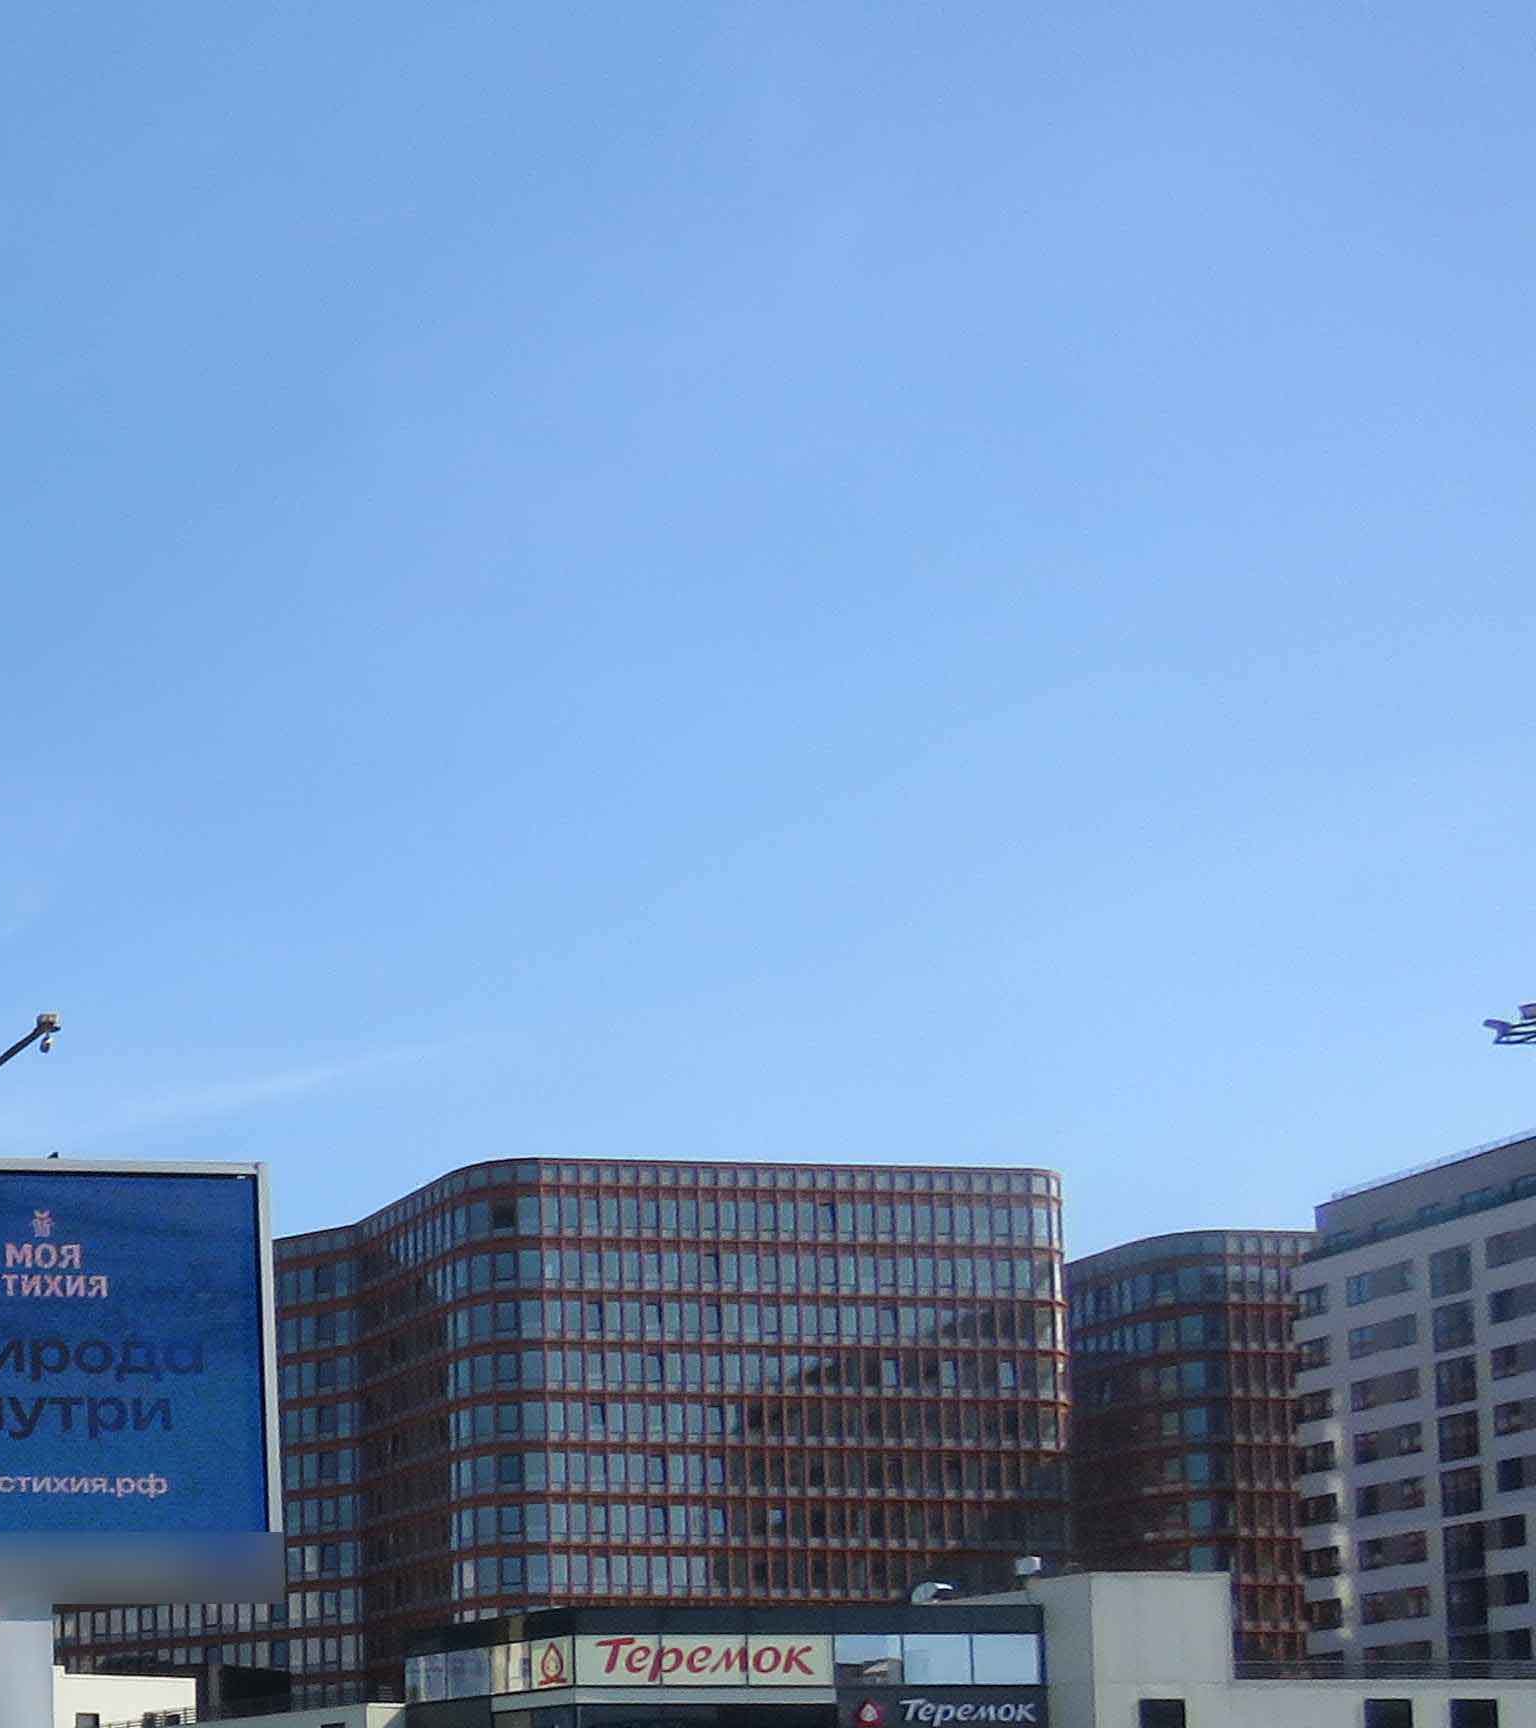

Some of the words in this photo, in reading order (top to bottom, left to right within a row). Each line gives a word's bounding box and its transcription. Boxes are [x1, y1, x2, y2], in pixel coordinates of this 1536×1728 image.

[5, 1241, 82, 1269] МОЯ
[595, 1636, 815, 1682] Теремок
[899, 1697, 1037, 1728] Теремок
